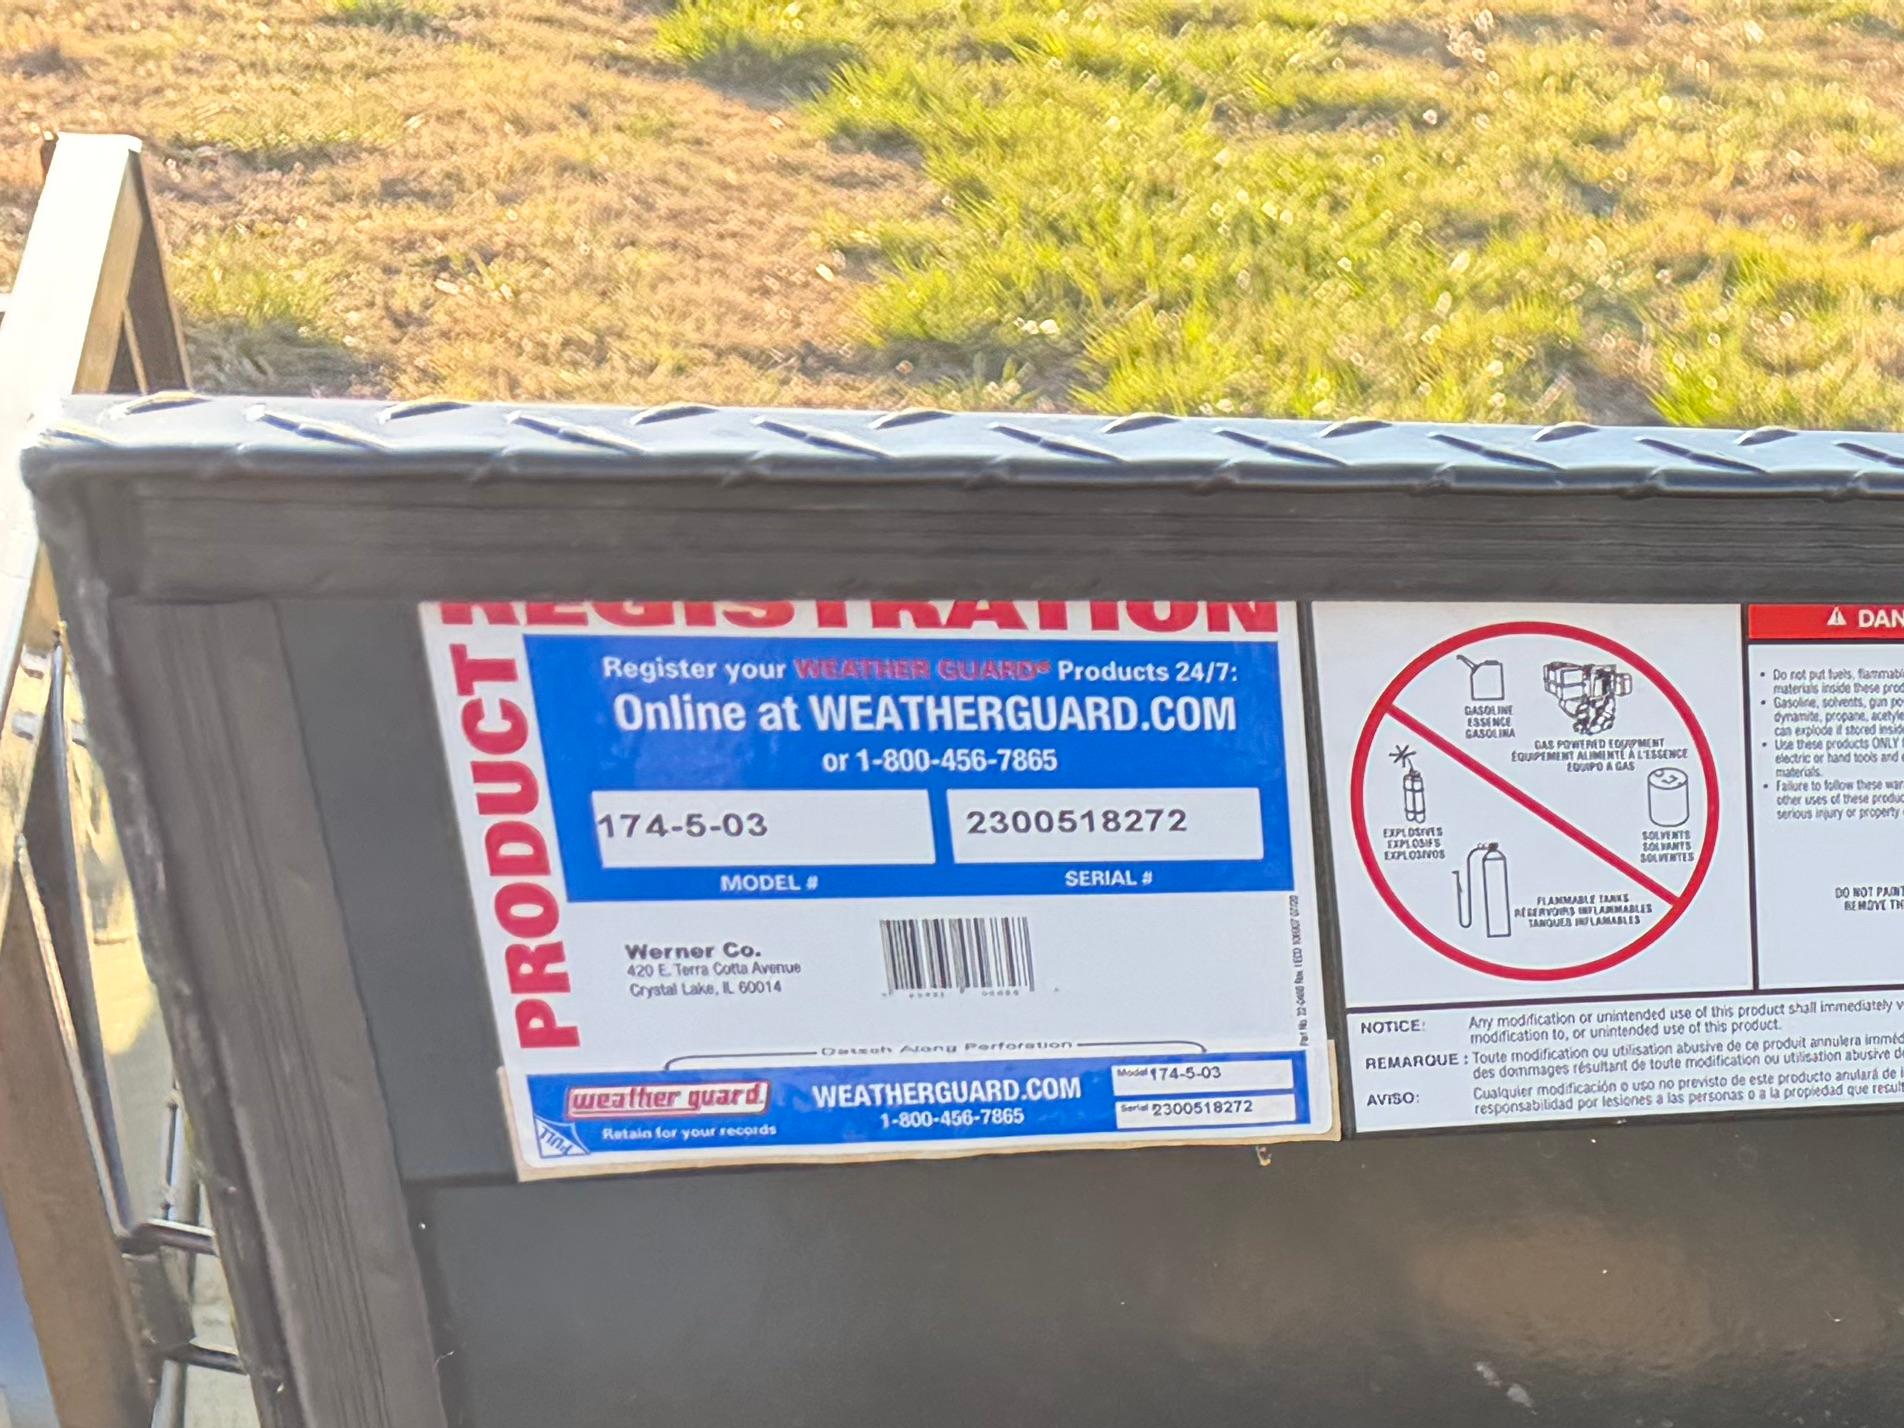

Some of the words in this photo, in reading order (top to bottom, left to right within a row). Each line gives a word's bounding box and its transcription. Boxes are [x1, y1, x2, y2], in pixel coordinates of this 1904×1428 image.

[602, 656, 717, 682] Register
[724, 662, 786, 683] your
[794, 659, 932, 682] WEATHER
[1058, 660, 1170, 682] Products
[1175, 661, 1239, 684] 24/7:
[614, 693, 746, 732] Online
[758, 694, 801, 732] at
[807, 694, 1237, 732] WEATHERGUARD.COM
[1465, 705, 1513, 716] GASOLINE
[1468, 717, 1511, 728] ESSENCE
[1466, 728, 1515, 739] GASOLINA
[821, 752, 849, 774] or
[854, 747, 1059, 773] 1-800-456-7865
[1859, 807, 1900, 820] property
[597, 811, 769, 839] 174-5-03
[966, 808, 1188, 835] 2300518272
[1383, 827, 1443, 838] EXPLOSIVES
[1642, 830, 1690, 841] SOLVENTS
[451, 643, 581, 1049] PRODUCT
[1387, 839, 1441, 849] EXPLOSIFS
[1384, 850, 1446, 861] EXPLOSIVOS
[720, 874, 794, 894] MODEL
[800, 874, 819, 893] #
[1064, 869, 1136, 889] SERIAL
[1139, 869, 1153, 888] #
[1537, 895, 1596, 906] FLAMMABLE
[1599, 894, 1629, 904] TANKS
[1835, 887, 1850, 899] DO
[1853, 886, 1873, 898] NOT
[1844, 900, 1886, 911] REMOVE
[624, 943, 715, 961] Werner
[722, 941, 762, 959] Co.
[627, 964, 655, 978] 420
[658, 963, 673, 978] E.
[674, 962, 710, 977] Terra
[712, 961, 749, 976] Cotta
[752, 960, 802, 976] Avenue
[629, 982, 679, 1000] Crystal
[681, 981, 719, 998] Lake,
[723, 981, 735, 996] IL
[738, 979, 783, 995] 60014
[1361, 1020, 1425, 1034] NOTICE:
[1468, 1016, 1493, 1031] Any
[1498, 1013, 1575, 1027] modification
[1579, 1014, 1592, 1024] or
[1597, 1008, 1665, 1023] unintended
[1670, 1009, 1692, 1020] use
[1696, 1006, 1707, 1018] of
[1712, 1006, 1734, 1018] this
[1738, 1004, 1784, 1018] product
[1789, 1002, 1816, 1014] shall
[1820, 1000, 1892, 1014] immediately
[1366, 1053, 1459, 1070] REMARQUE
[1151, 1066, 1222, 1081] 174-5-03
[572, 1086, 682, 1111] weather
[812, 1077, 1082, 1108] WEATHERGUARD.COM
[1367, 1092, 1419, 1106] AVISO:
[1152, 1099, 1253, 1117] 2300518272
[880, 1108, 1025, 1128] 1-800-456-7865
[602, 1127, 652, 1140] Retain
[655, 1127, 677, 1139] for
[681, 1127, 715, 1141] your
[719, 1124, 777, 1138] records
